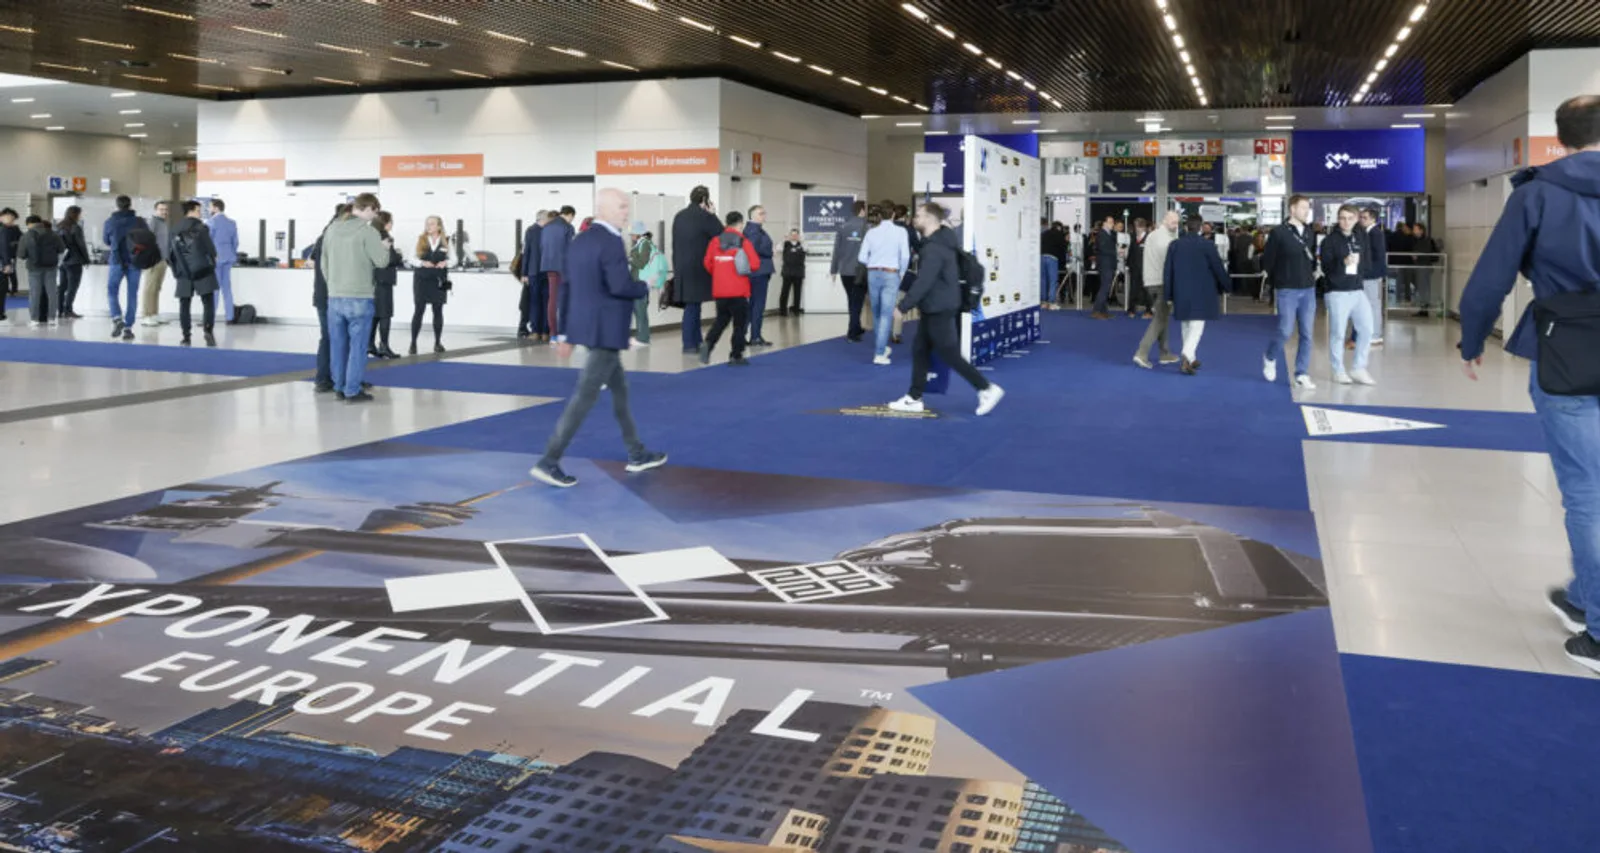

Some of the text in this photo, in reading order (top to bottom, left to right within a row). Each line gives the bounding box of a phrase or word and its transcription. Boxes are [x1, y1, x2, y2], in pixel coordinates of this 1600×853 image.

[1179, 142, 1205, 155] 1+3
[1546, 145, 1567, 157] He
[656, 156, 706, 167] Information
[18, 583, 821, 743] XPONENTIAL
[121, 651, 496, 741] EUROPE
